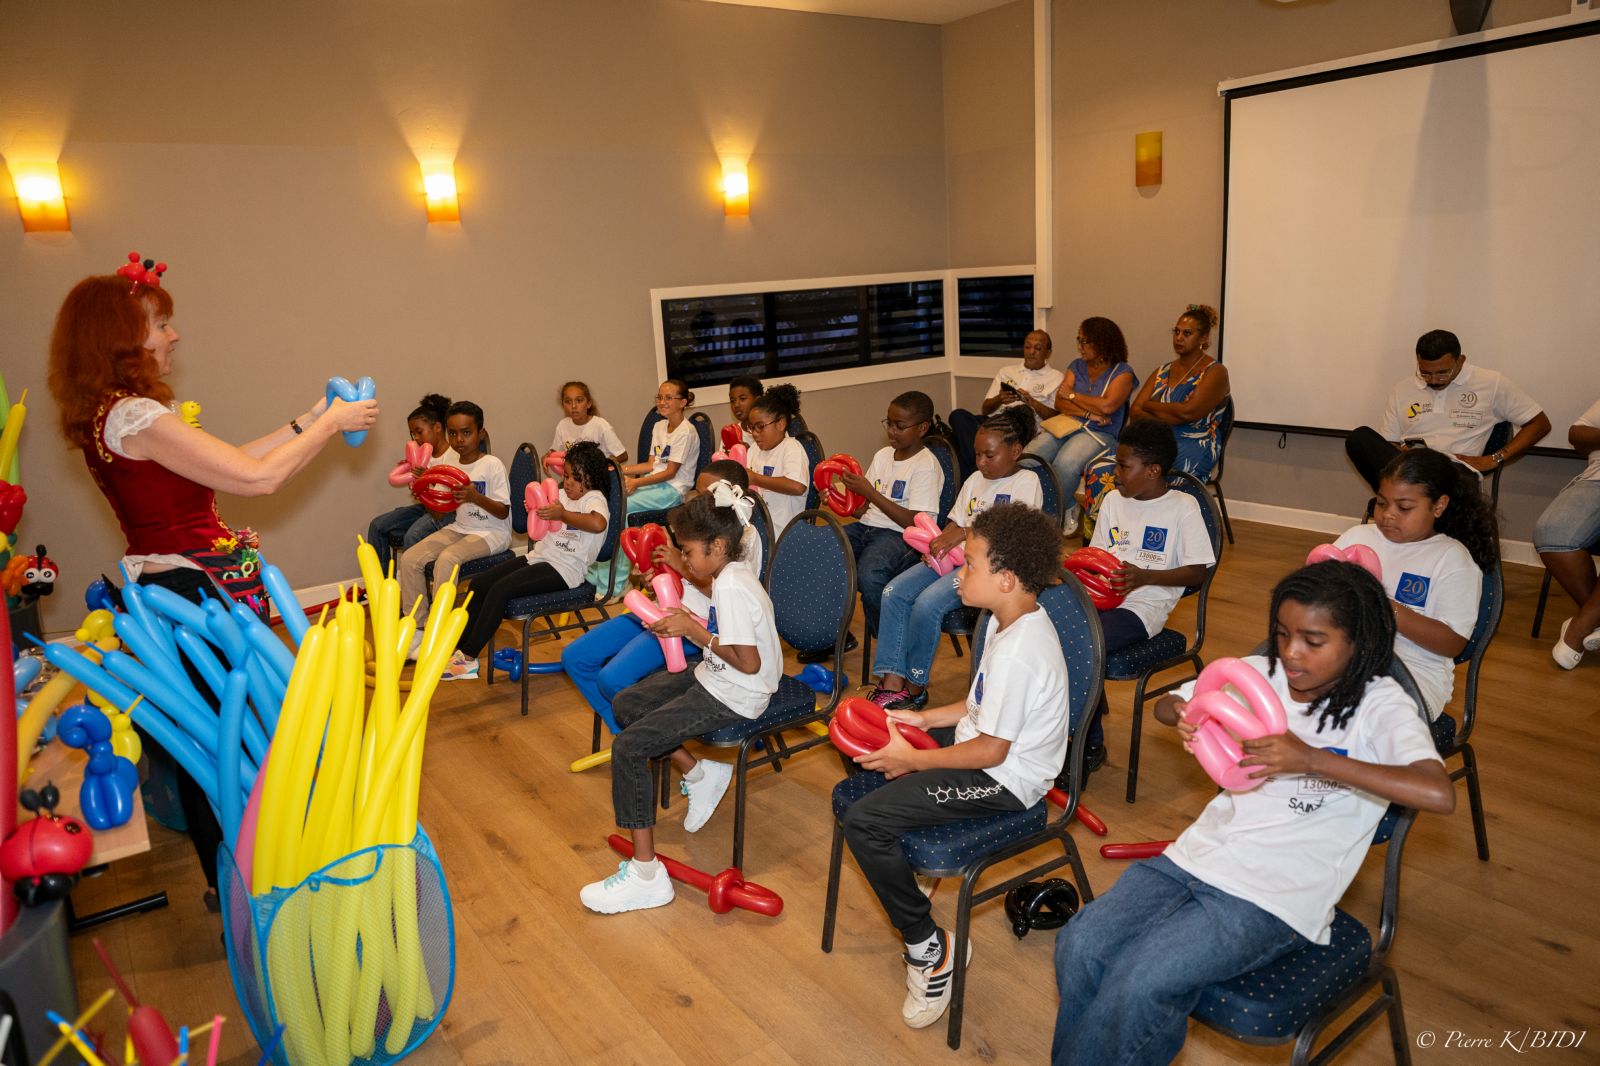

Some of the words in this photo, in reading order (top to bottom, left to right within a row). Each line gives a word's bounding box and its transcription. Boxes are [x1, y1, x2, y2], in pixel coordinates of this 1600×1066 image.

[1460, 393, 1475, 403] 20
[1147, 530, 1162, 543] 20
[1401, 578, 1424, 595] 20
[1302, 779, 1338, 789] 13000
